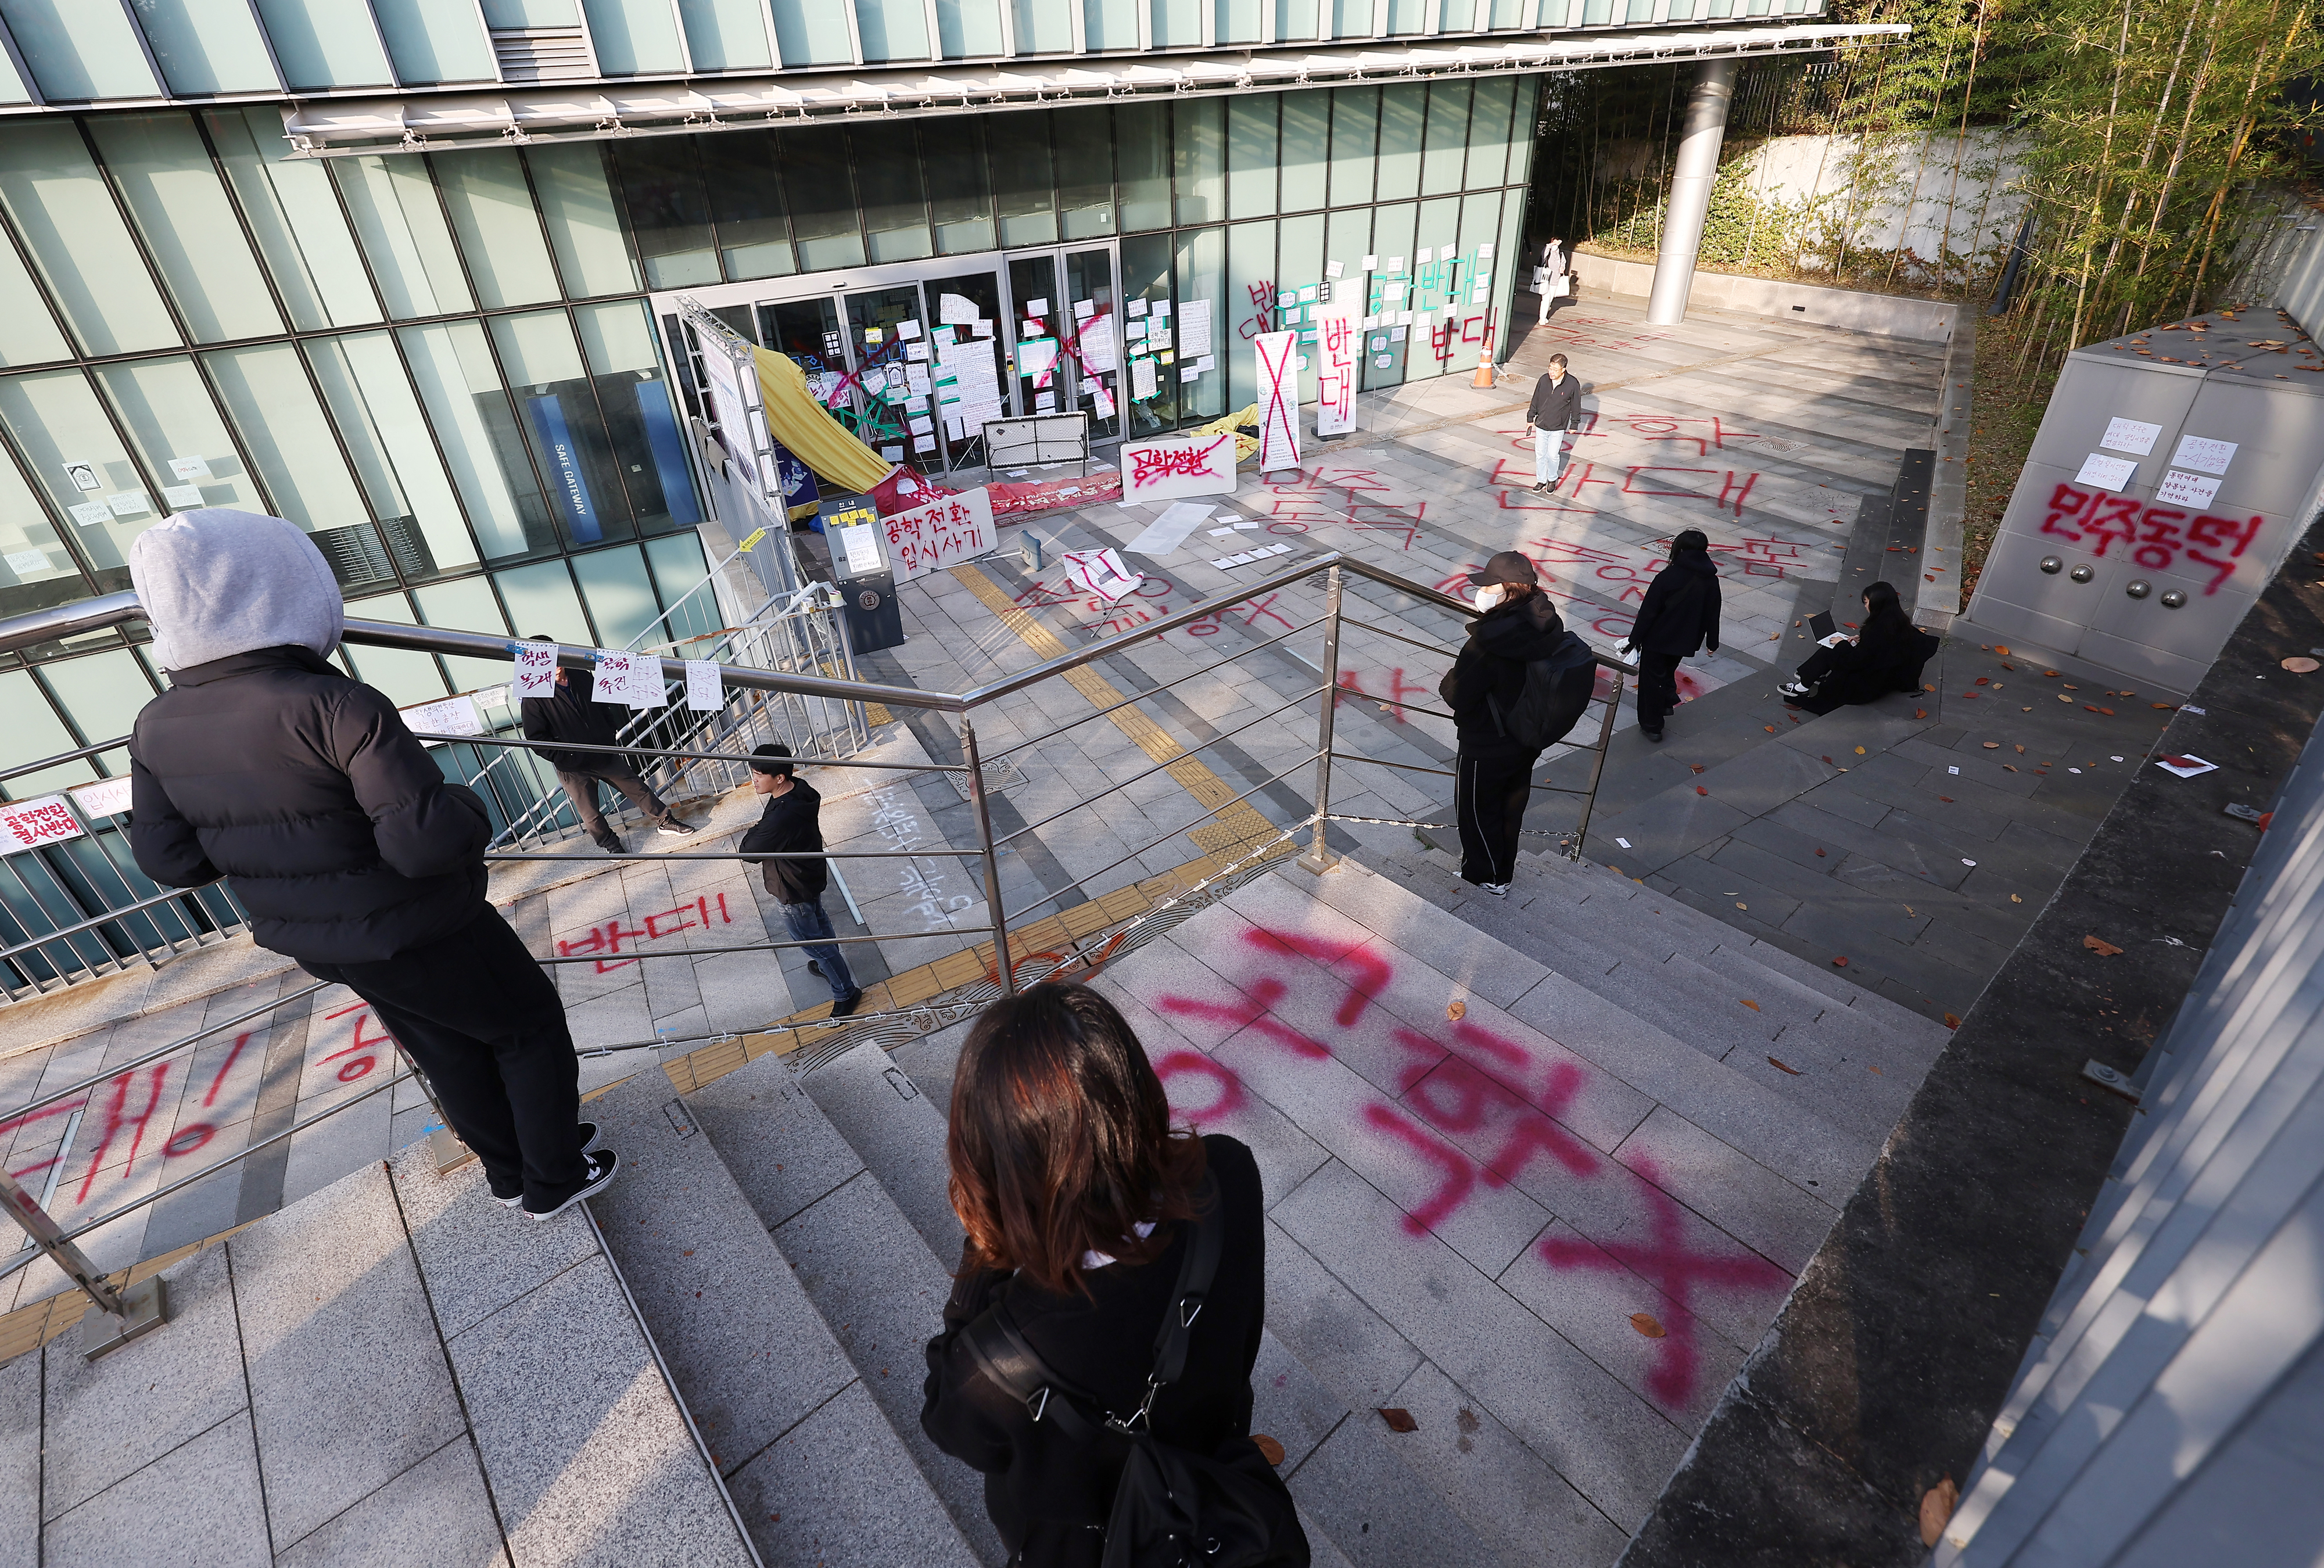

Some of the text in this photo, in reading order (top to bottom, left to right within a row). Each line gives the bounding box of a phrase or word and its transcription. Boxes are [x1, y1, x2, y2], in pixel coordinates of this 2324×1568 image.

[1432, 307, 1497, 361] 반대
[1319, 317, 1353, 422] 반대
[555, 444, 587, 515] SAFE GATEWAY
[2165, 482, 2213, 498] 알몸남 사건을
[2169, 472, 2199, 483] 동덕여대
[2160, 491, 2189, 504] 기억하라
[2040, 483, 2264, 597] 민주동덕
[520, 670, 554, 690] 몰래
[597, 675, 630, 695] 추진
[415, 711, 461, 732] 무능한 총장
[4, 802, 69, 827] 공학전환
[12, 816, 82, 845] 결사반대
[558, 891, 732, 975] 반대
